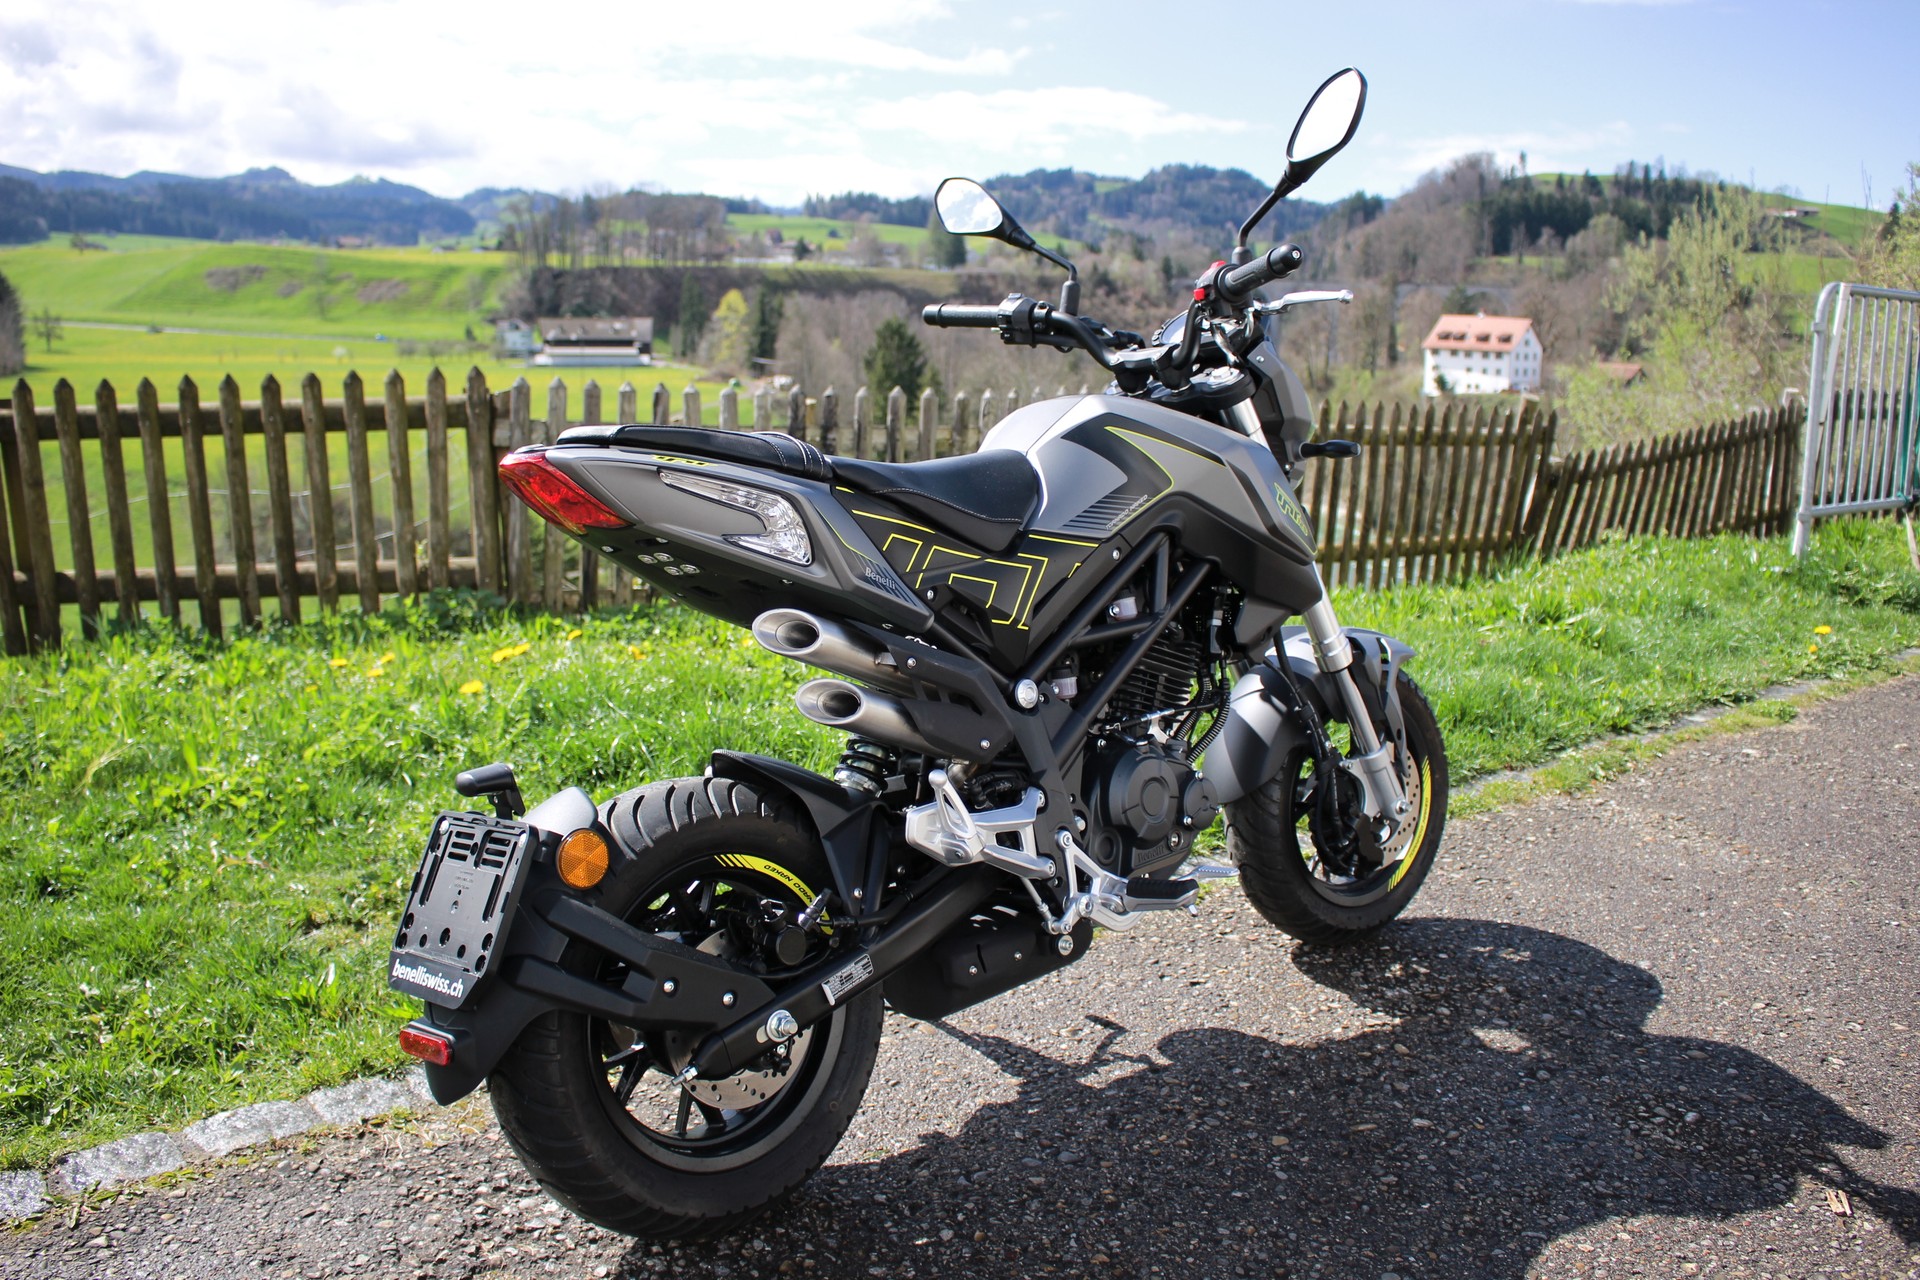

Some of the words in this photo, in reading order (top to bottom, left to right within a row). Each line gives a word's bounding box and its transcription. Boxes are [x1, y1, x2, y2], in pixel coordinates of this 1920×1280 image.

[865, 566, 896, 590] Benelli
[763, 864, 793, 882] NAKED
[793, 882, 813, 903] NADO
[392, 958, 464, 998] benelliswiss.ch
